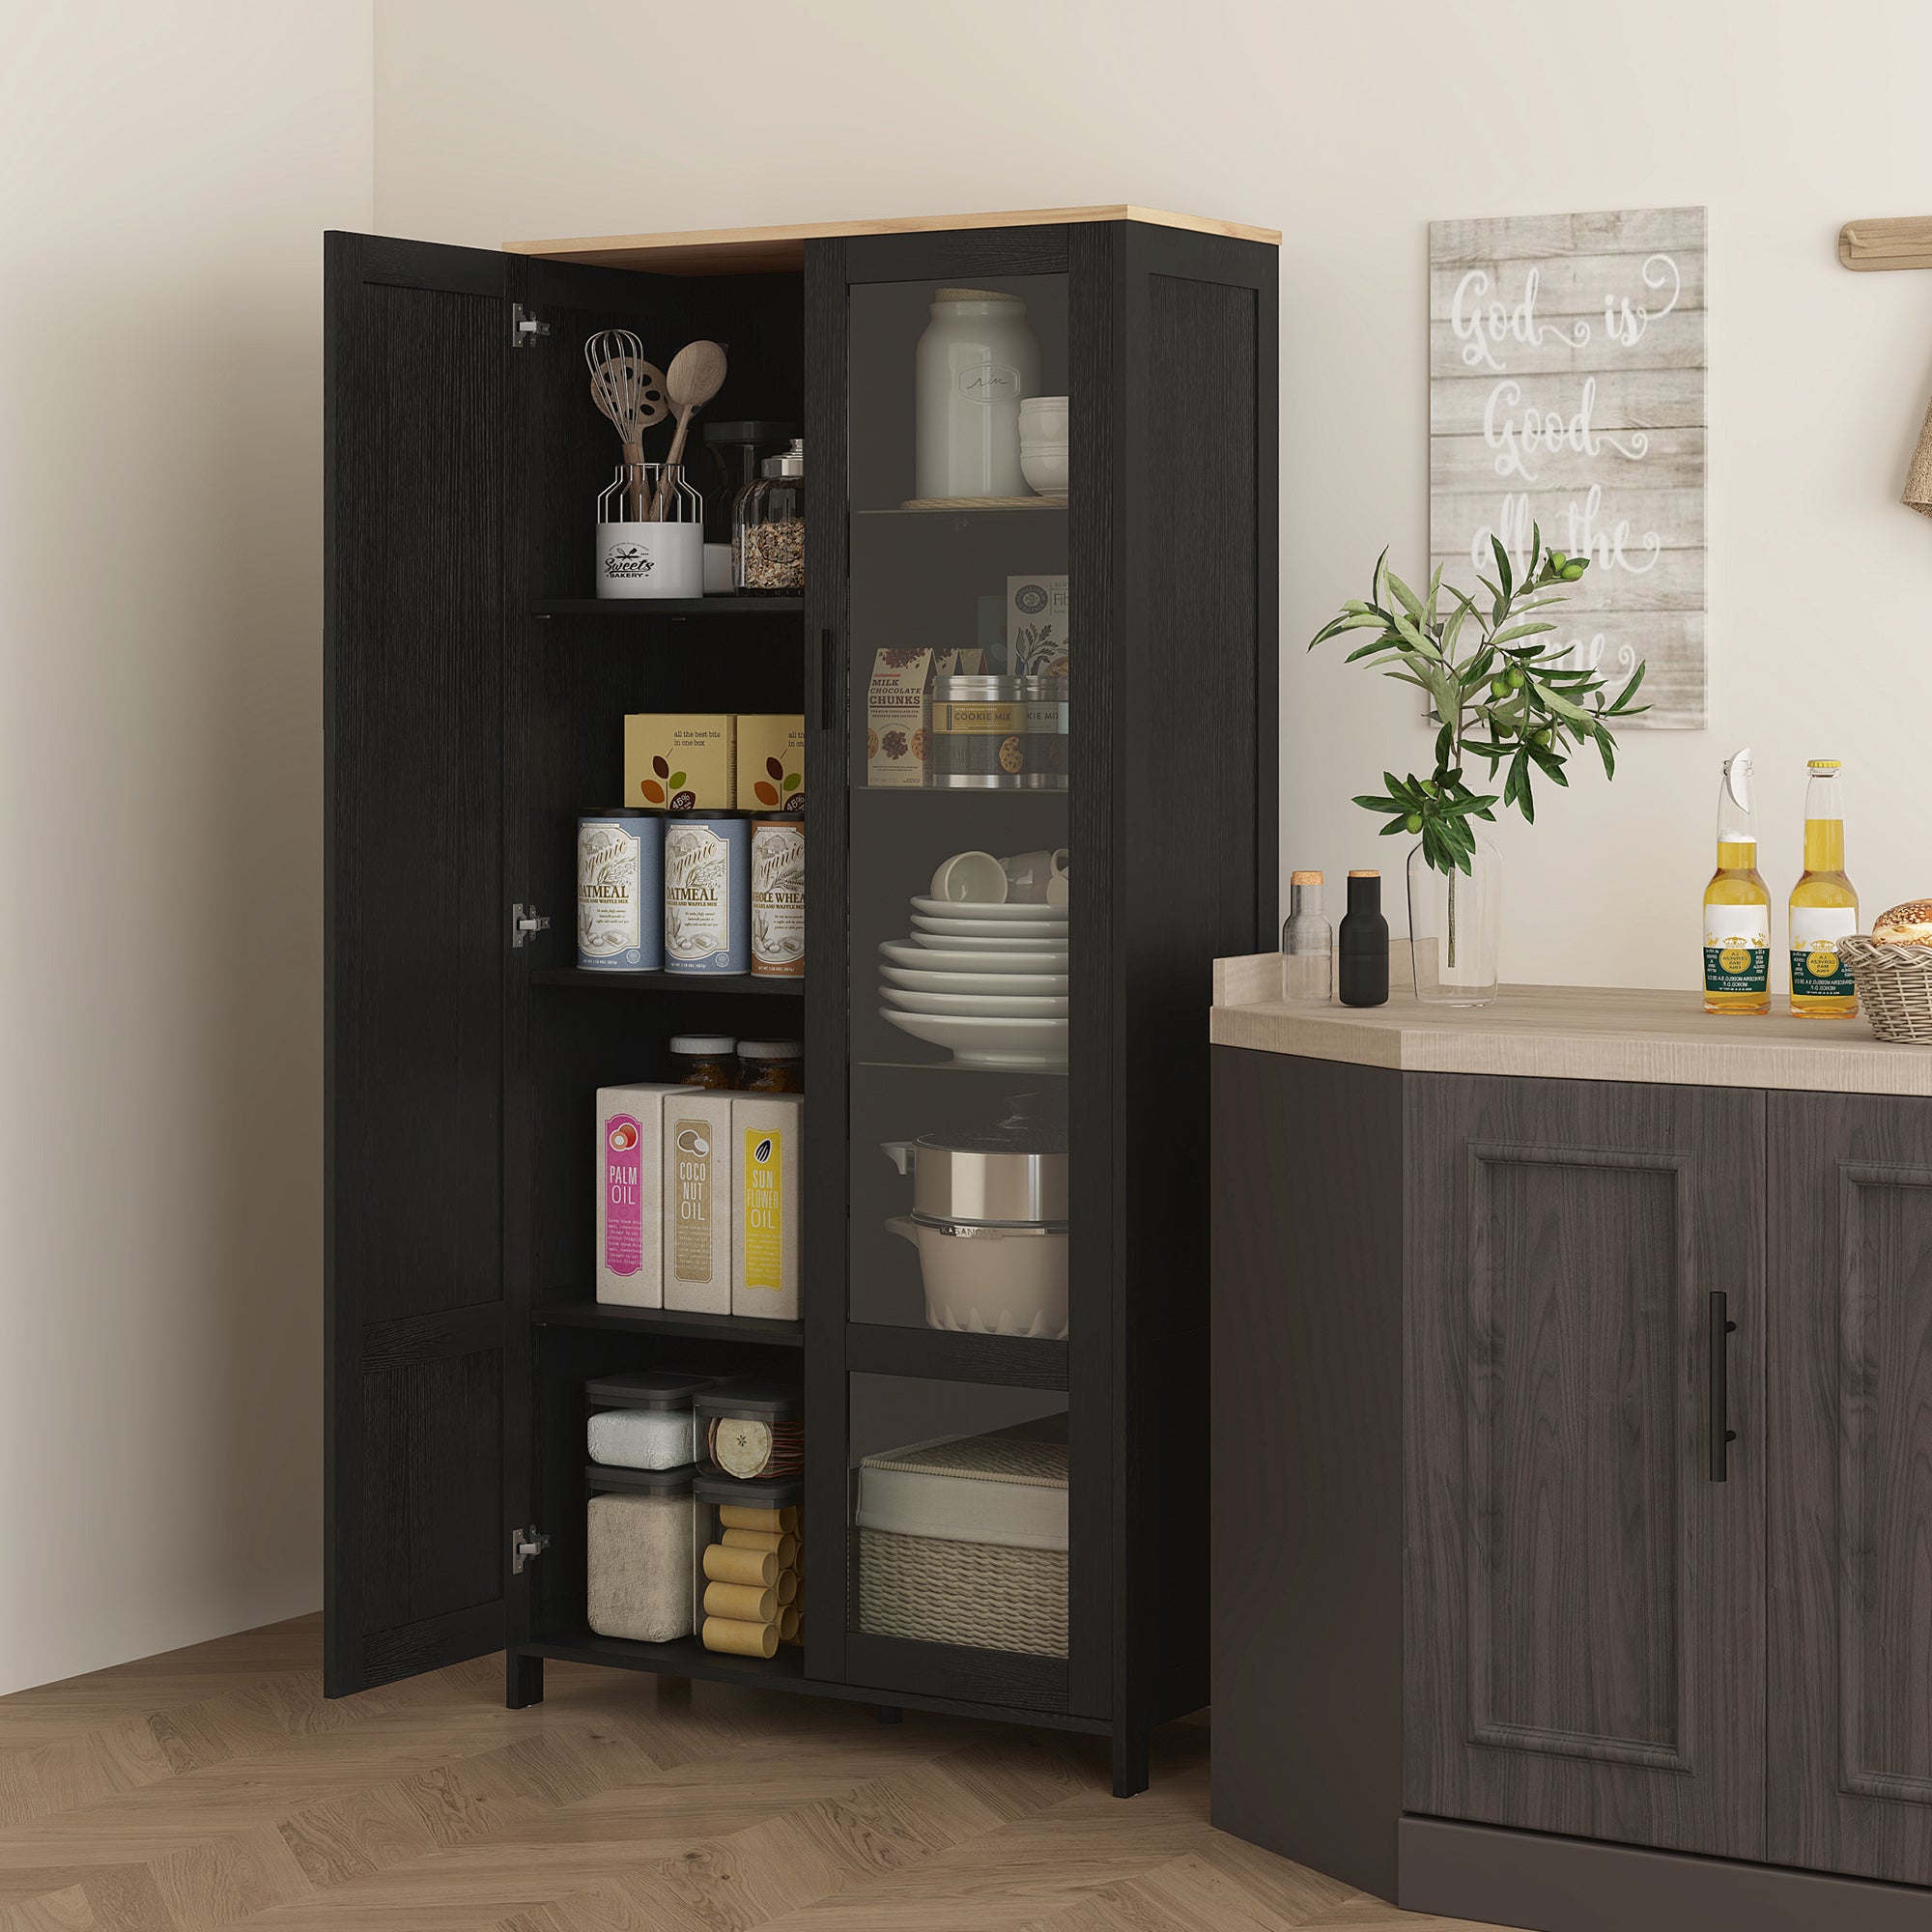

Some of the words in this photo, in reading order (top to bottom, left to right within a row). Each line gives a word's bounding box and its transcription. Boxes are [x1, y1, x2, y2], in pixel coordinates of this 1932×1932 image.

[1451, 267, 1590, 369] God
[1605, 254, 1680, 347] is
[1484, 376, 1648, 482] Good
[1471, 493, 1536, 582] all
[1556, 484, 1660, 574] the
[604, 557, 655, 573] Sweets
[869, 696, 920, 704] CHUNKS
[954, 712, 992, 721] COOKIE
[994, 712, 1011, 721] MIX
[580, 838, 626, 884] Organic
[667, 840, 717, 887] Organic
[753, 842, 804, 889] Organic
[579, 883, 629, 898] OATMEAL
[667, 887, 718, 901] OATMEAL
[610, 1165, 638, 1185] PALM
[679, 1161, 706, 1181] COCO
[753, 1169, 774, 1189] SUN
[611, 1184, 636, 1205] OIL
[683, 1181, 703, 1201] NUT
[747, 1188, 779, 1209] FLOWER
[681, 1201, 705, 1221] OIL
[751, 1208, 775, 1229] OIL
[941, 1225, 999, 1238] KASANO
